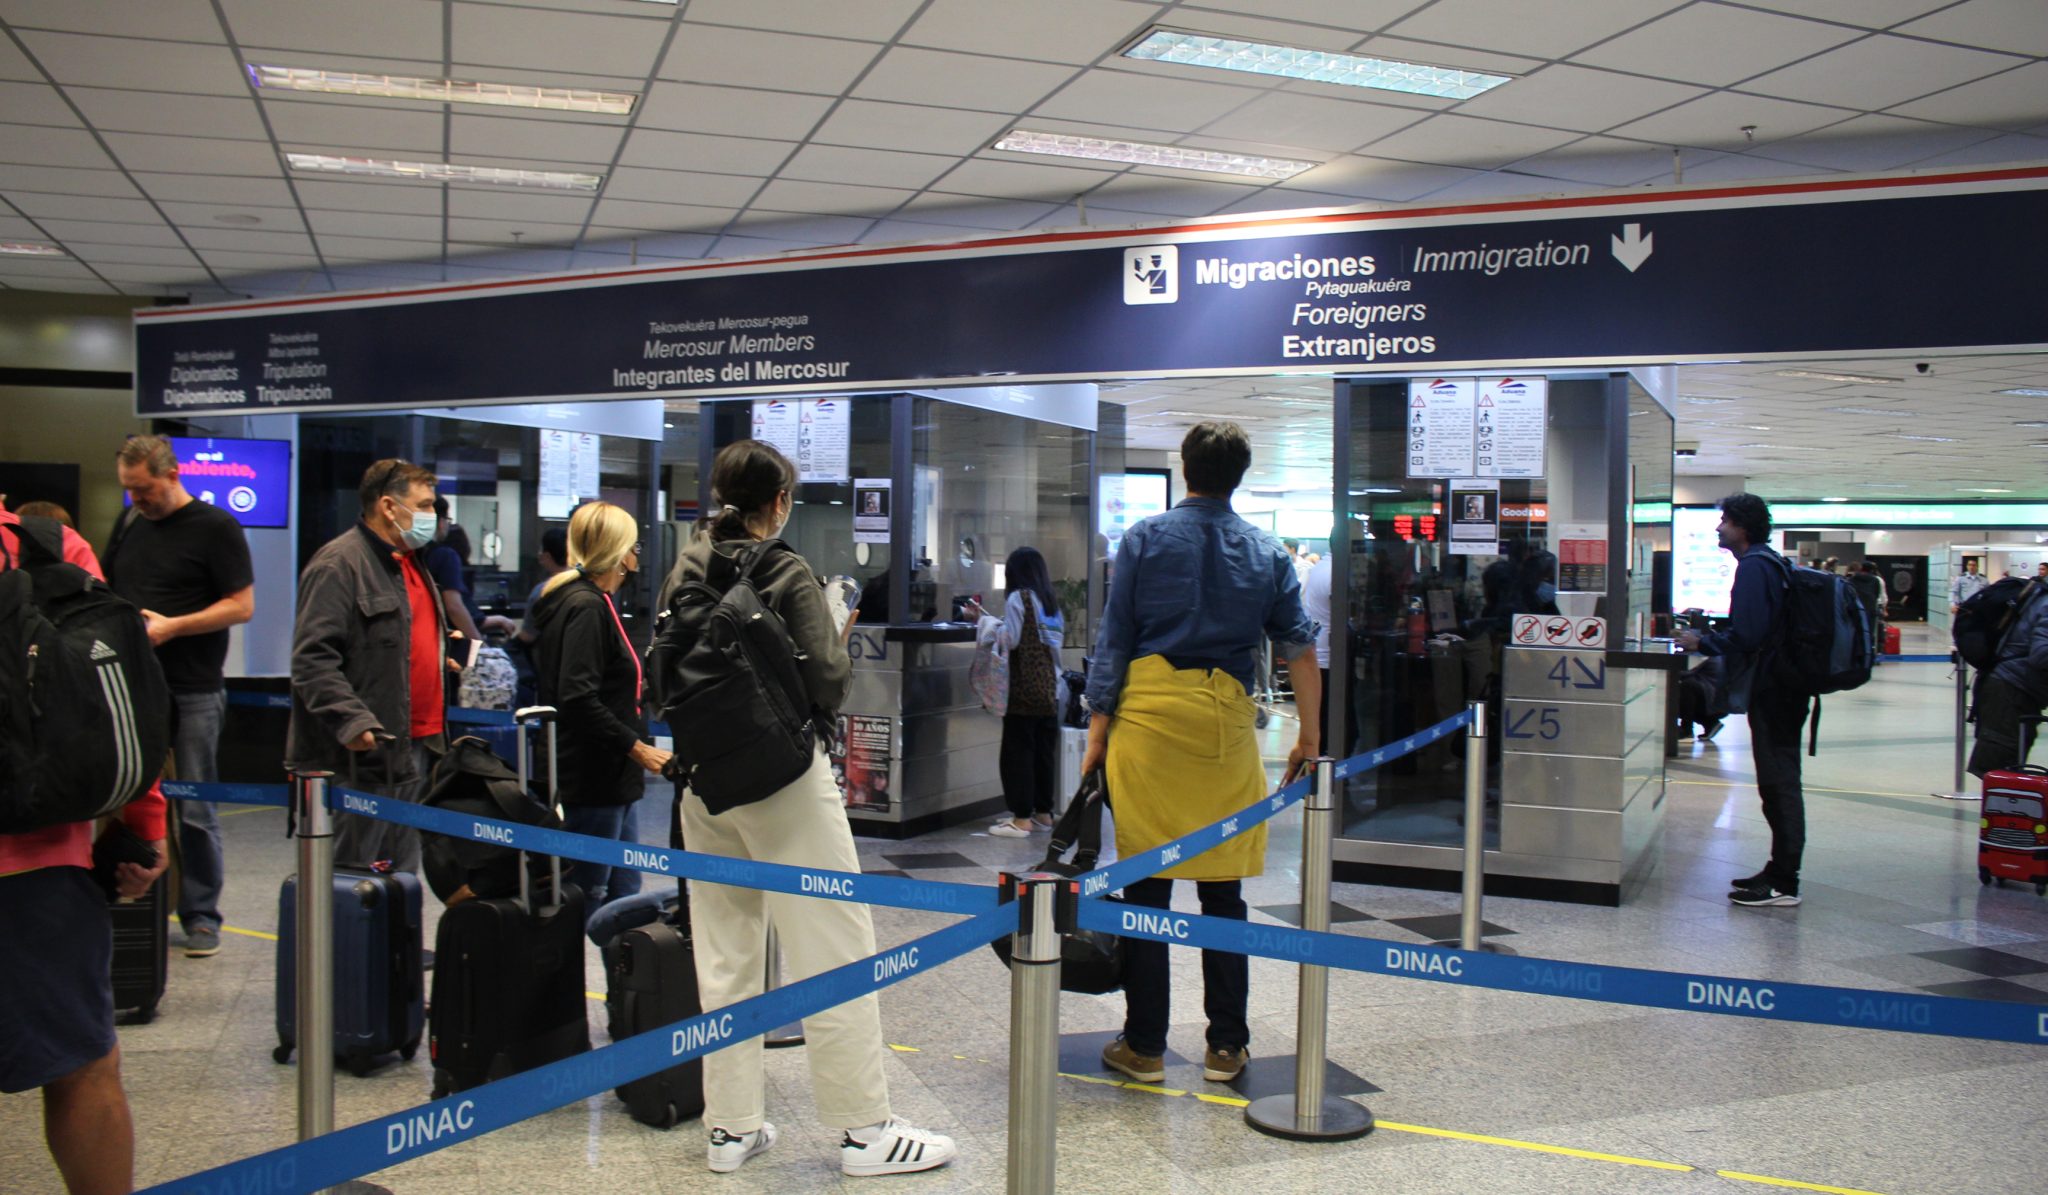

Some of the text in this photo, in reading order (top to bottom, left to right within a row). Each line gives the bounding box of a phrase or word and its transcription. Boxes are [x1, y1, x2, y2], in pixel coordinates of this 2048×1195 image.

[1196, 253, 1377, 289] Migraciones
[1413, 239, 1591, 276] Immigration
[1305, 276, 1412, 297] Pytaguakuéra
[649, 314, 809, 334] Tekovekuéra Mercosur-pegua
[1292, 300, 1428, 329] Foreigners
[643, 332, 816, 360] Mercosur Members
[1282, 334, 1437, 361] Extranjeros
[169, 364, 240, 386] Diplomatics
[262, 361, 328, 383] Tripulation
[612, 359, 850, 390] Integrantes del Mercosur
[162, 386, 247, 409] Diplomáticos
[256, 384, 333, 406] Tripulación
[177, 460, 257, 479] mbiente,
[1501, 506, 1546, 517] Goods to
[848, 632, 863, 659] 6
[1547, 655, 1571, 688] 4
[1539, 708, 1560, 740] 5
[343, 794, 379, 815] DINAC
[473, 822, 514, 844] DINAC
[623, 849, 670, 872] DINAC
[1162, 844, 1181, 866] DINAC
[801, 874, 854, 897] DINAC
[1084, 871, 1110, 896] DINAC
[1122, 910, 1190, 940] DINAC
[874, 946, 919, 983] DINAC
[1386, 947, 1464, 978] DINAC
[1687, 982, 1776, 1013] DINAC
[672, 1012, 734, 1057] DINAC
[386, 1099, 475, 1156] DINAC
